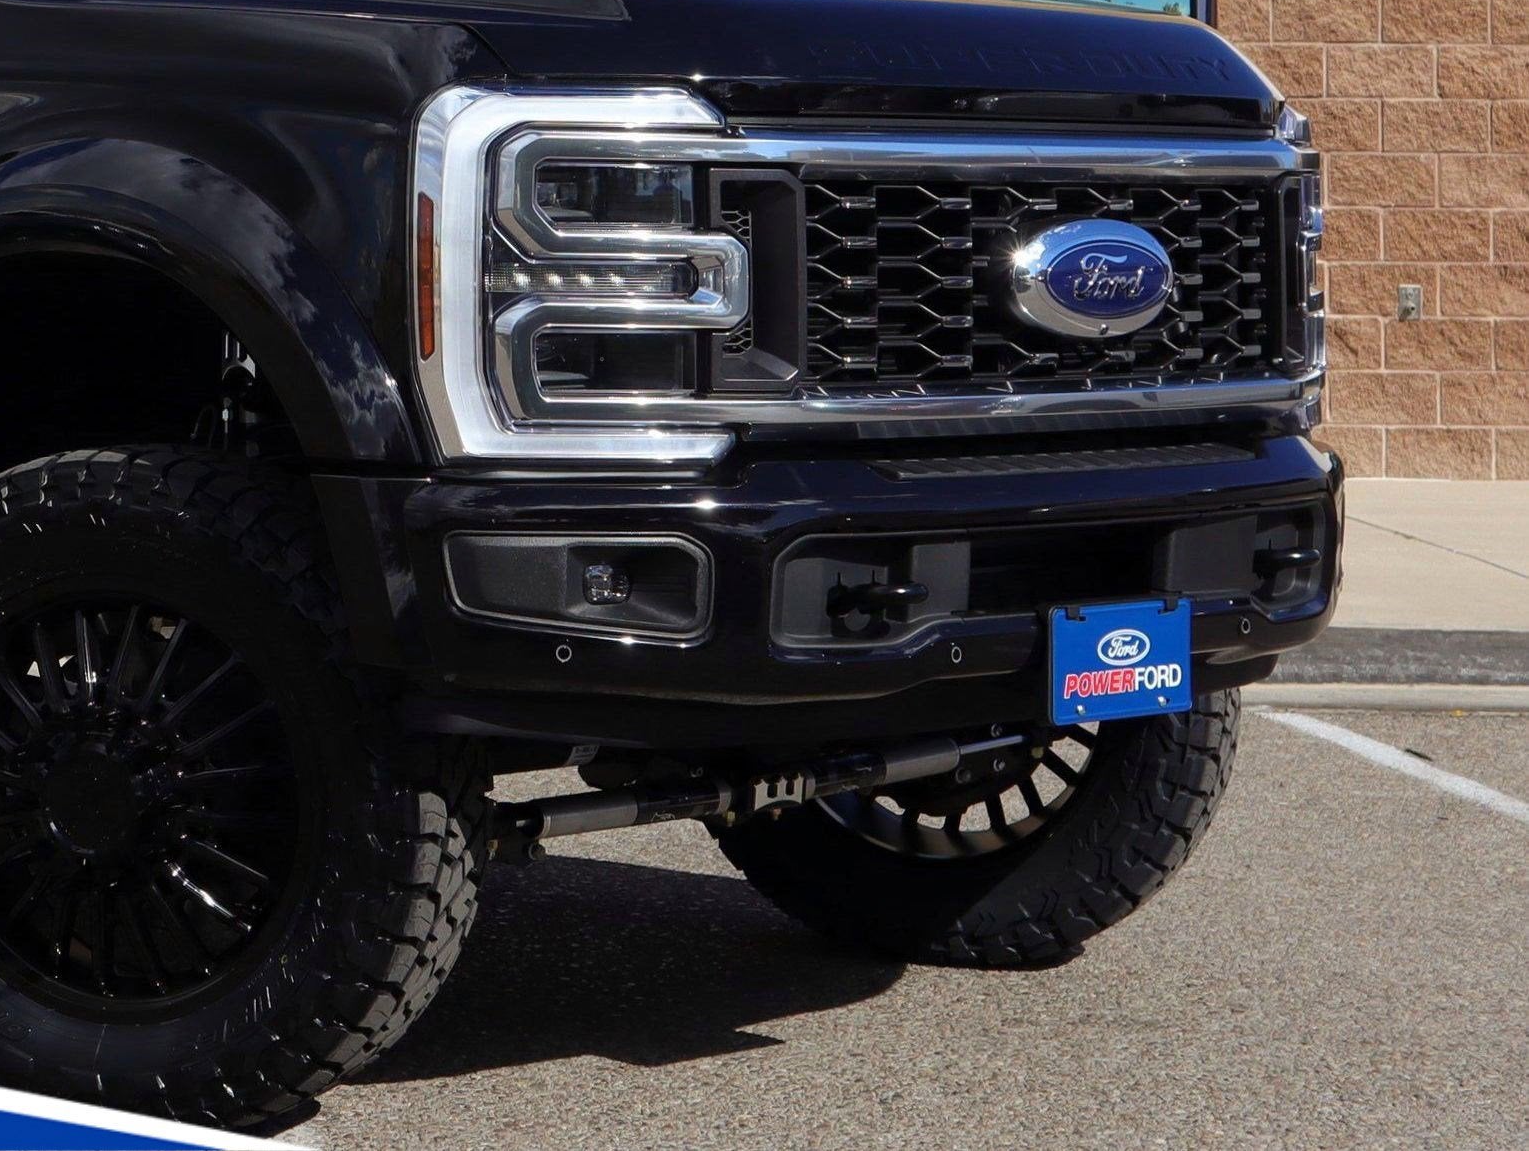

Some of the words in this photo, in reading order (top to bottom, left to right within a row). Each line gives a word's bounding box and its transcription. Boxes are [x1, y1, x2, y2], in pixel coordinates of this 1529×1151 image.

[1073, 252, 1146, 301] Ford
[1107, 635, 1139, 658] Ford
[1063, 663, 1182, 699] POWERFORD
